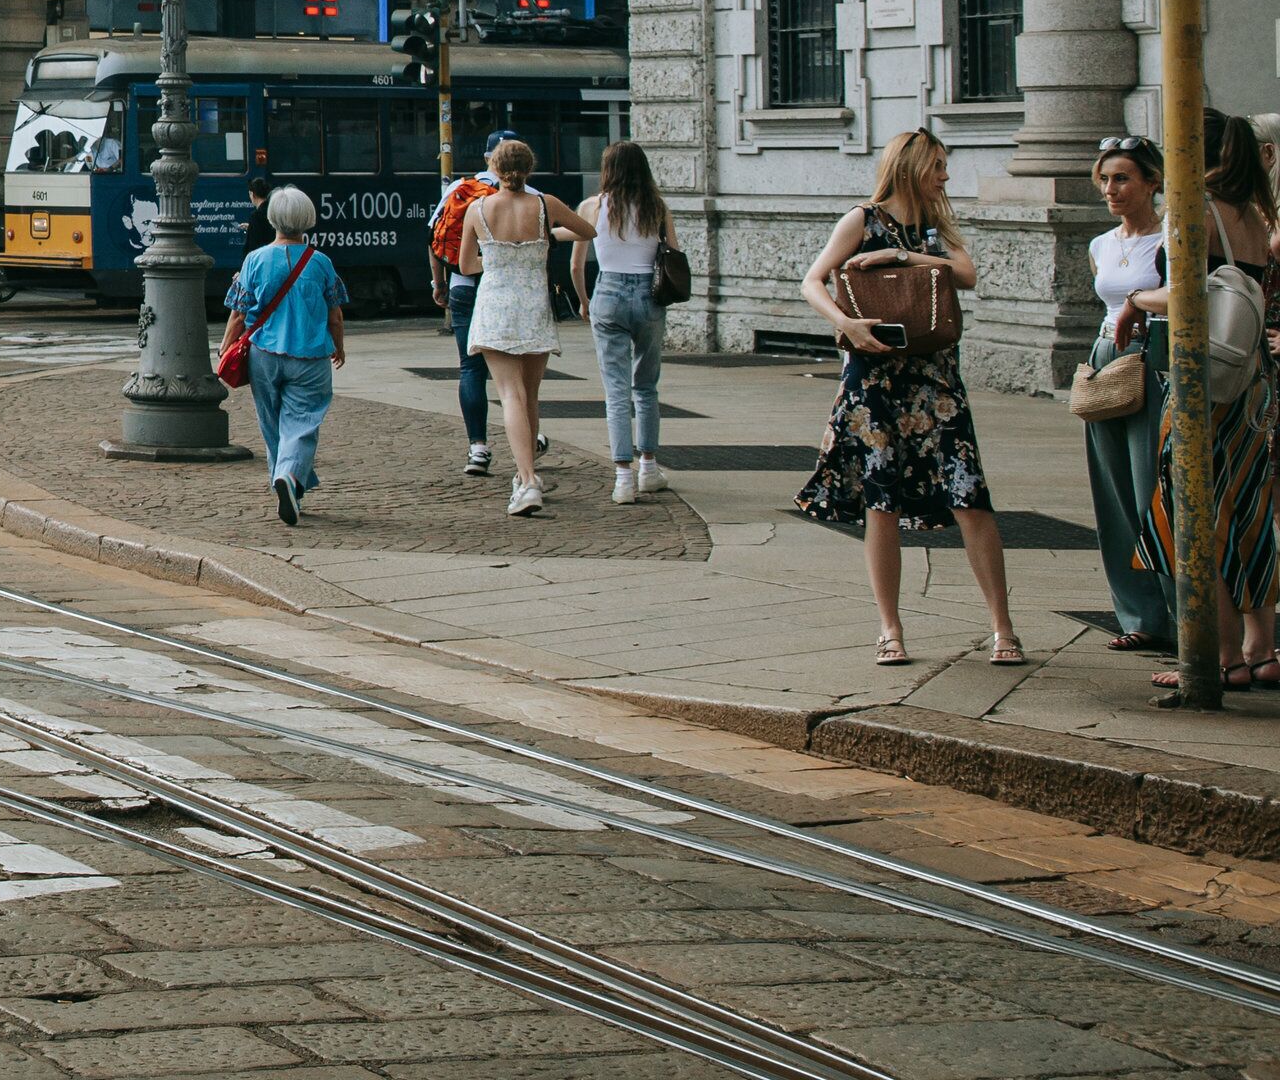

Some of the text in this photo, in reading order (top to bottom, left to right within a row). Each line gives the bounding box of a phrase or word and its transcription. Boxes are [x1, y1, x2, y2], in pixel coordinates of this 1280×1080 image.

[372, 75, 393, 85] 4601
[32, 191, 48, 201] 4601
[320, 192, 402, 220] 5x1000
[406, 204, 426, 218] alla
[302, 231, 397, 247] 04793650583
